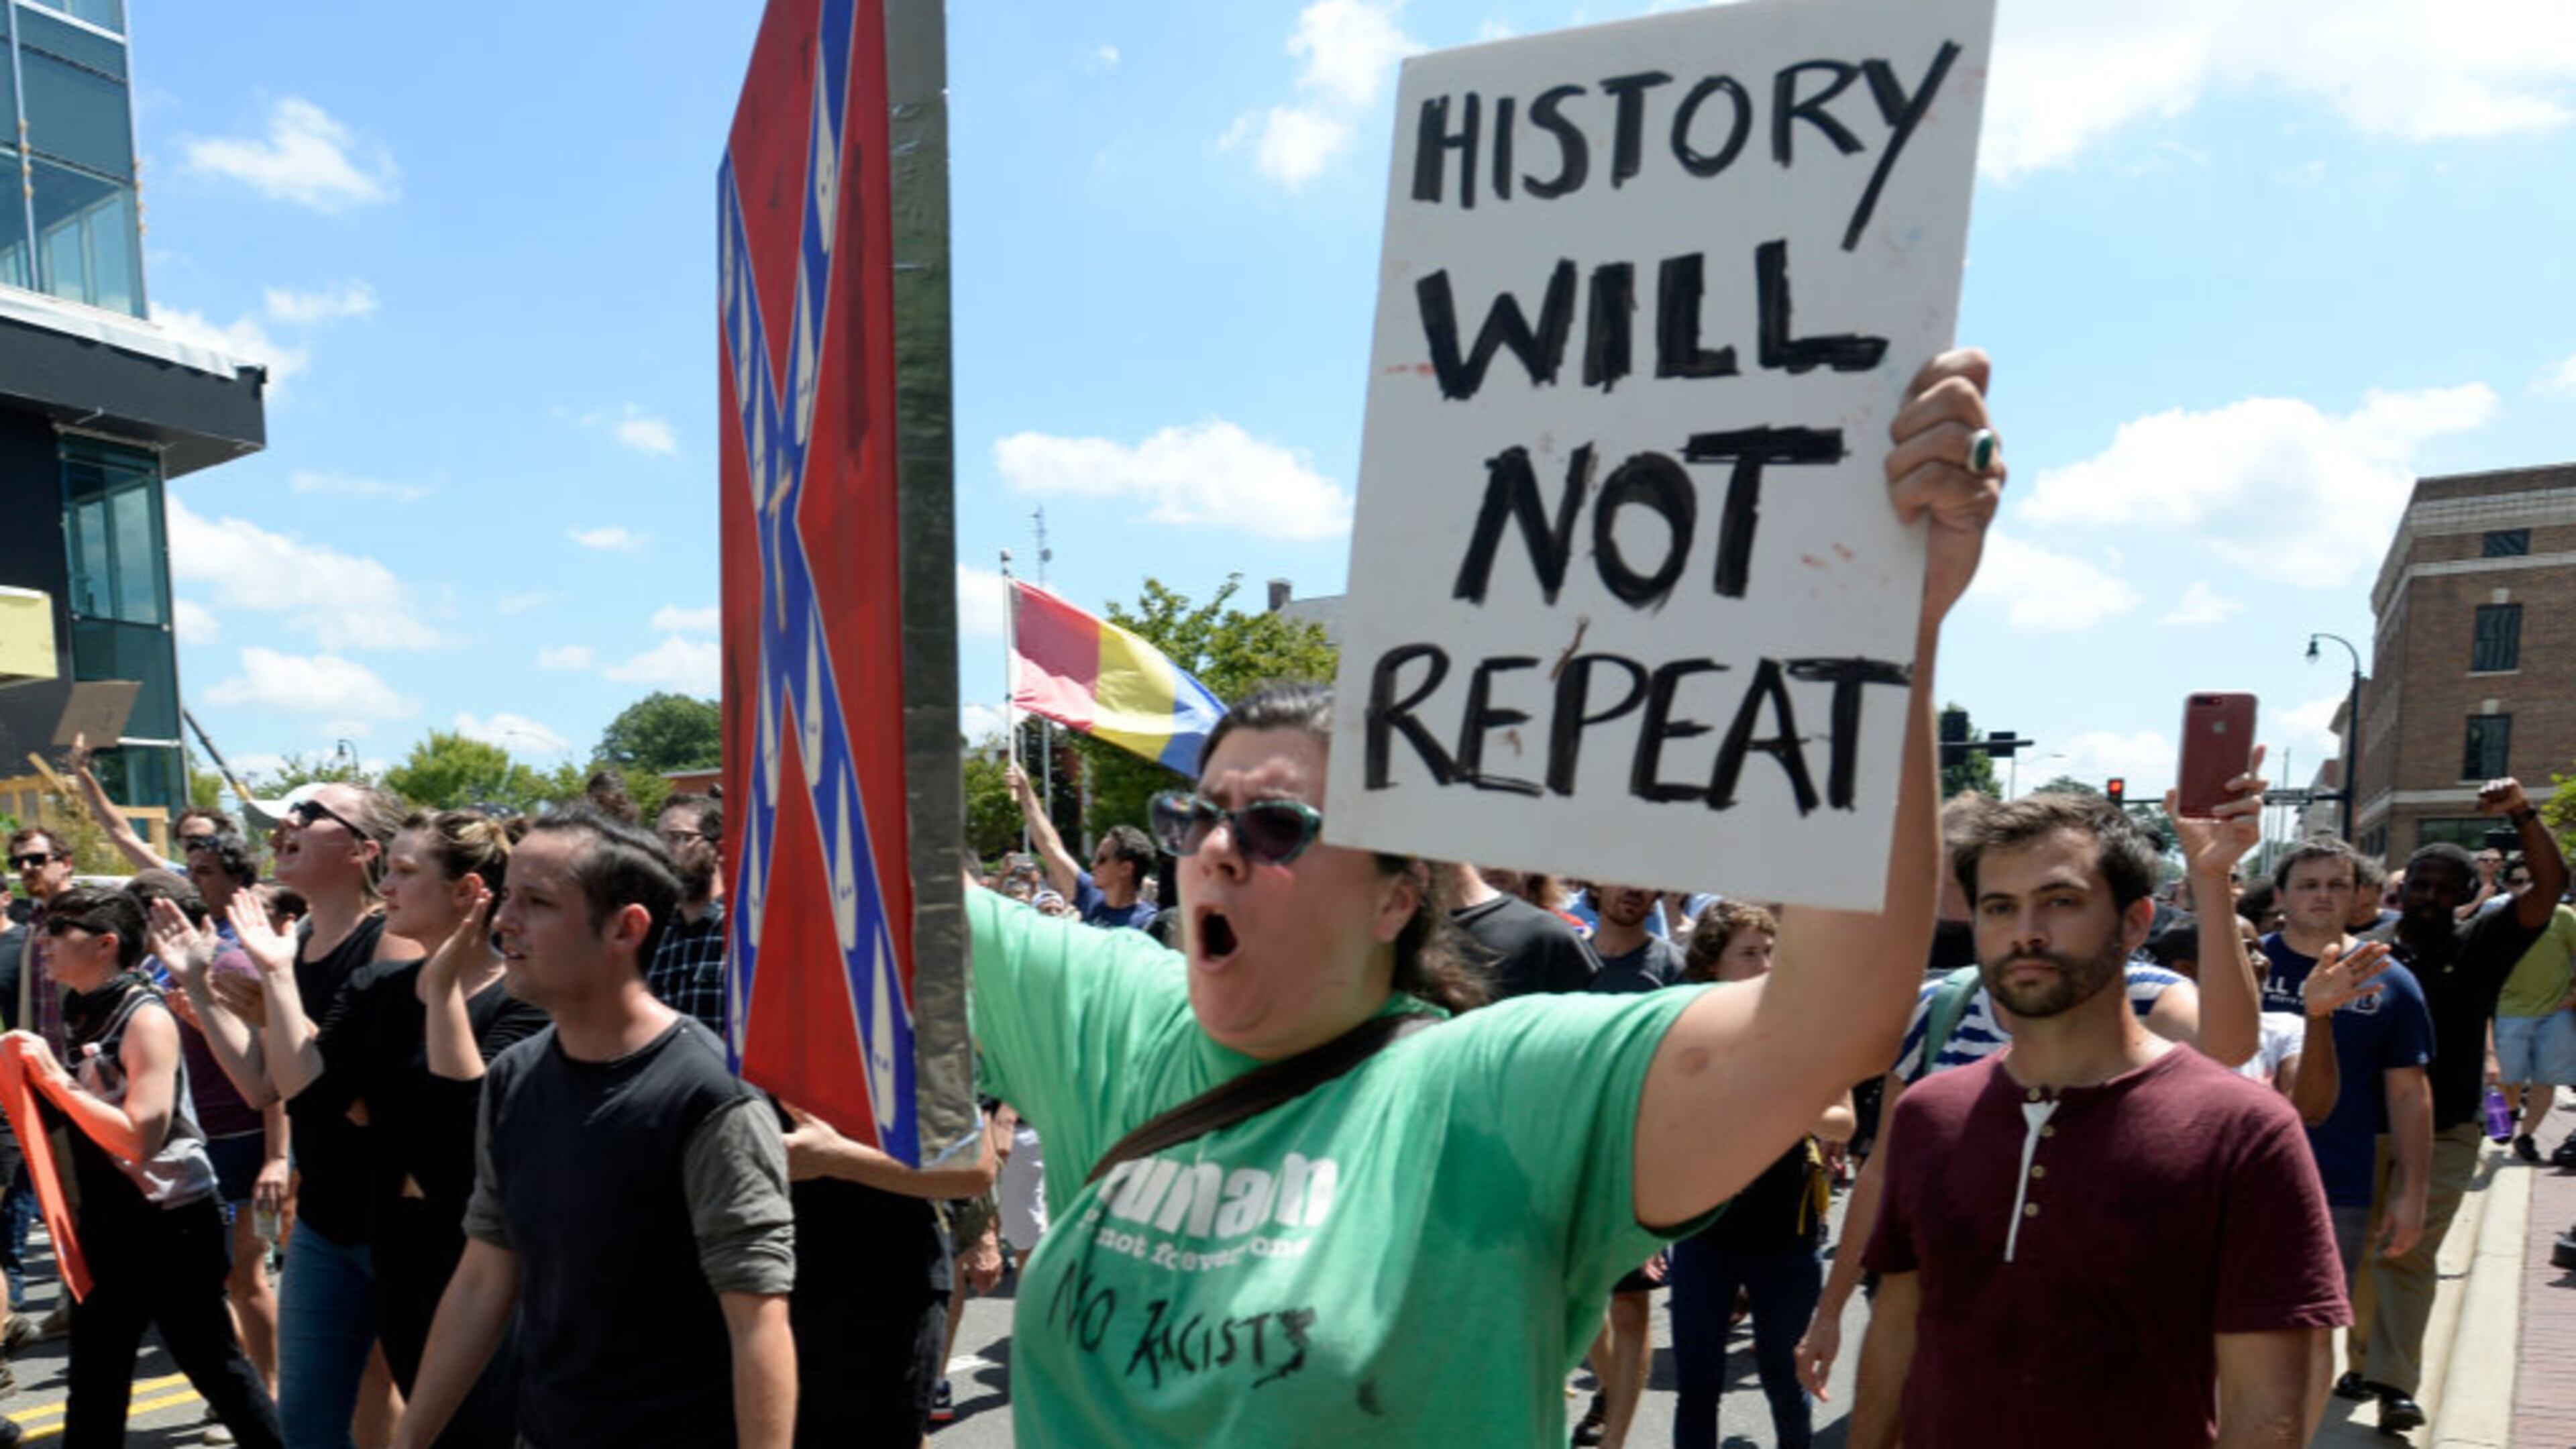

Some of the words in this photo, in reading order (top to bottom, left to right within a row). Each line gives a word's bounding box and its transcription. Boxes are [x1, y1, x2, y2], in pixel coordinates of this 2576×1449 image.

[1411, 40, 1962, 252] HISTORY
[1416, 239, 1890, 400] WILL
[1452, 425, 1851, 613] NOT
[1364, 643, 1914, 818] REPEAT
[1047, 1261, 1116, 1353] NO
